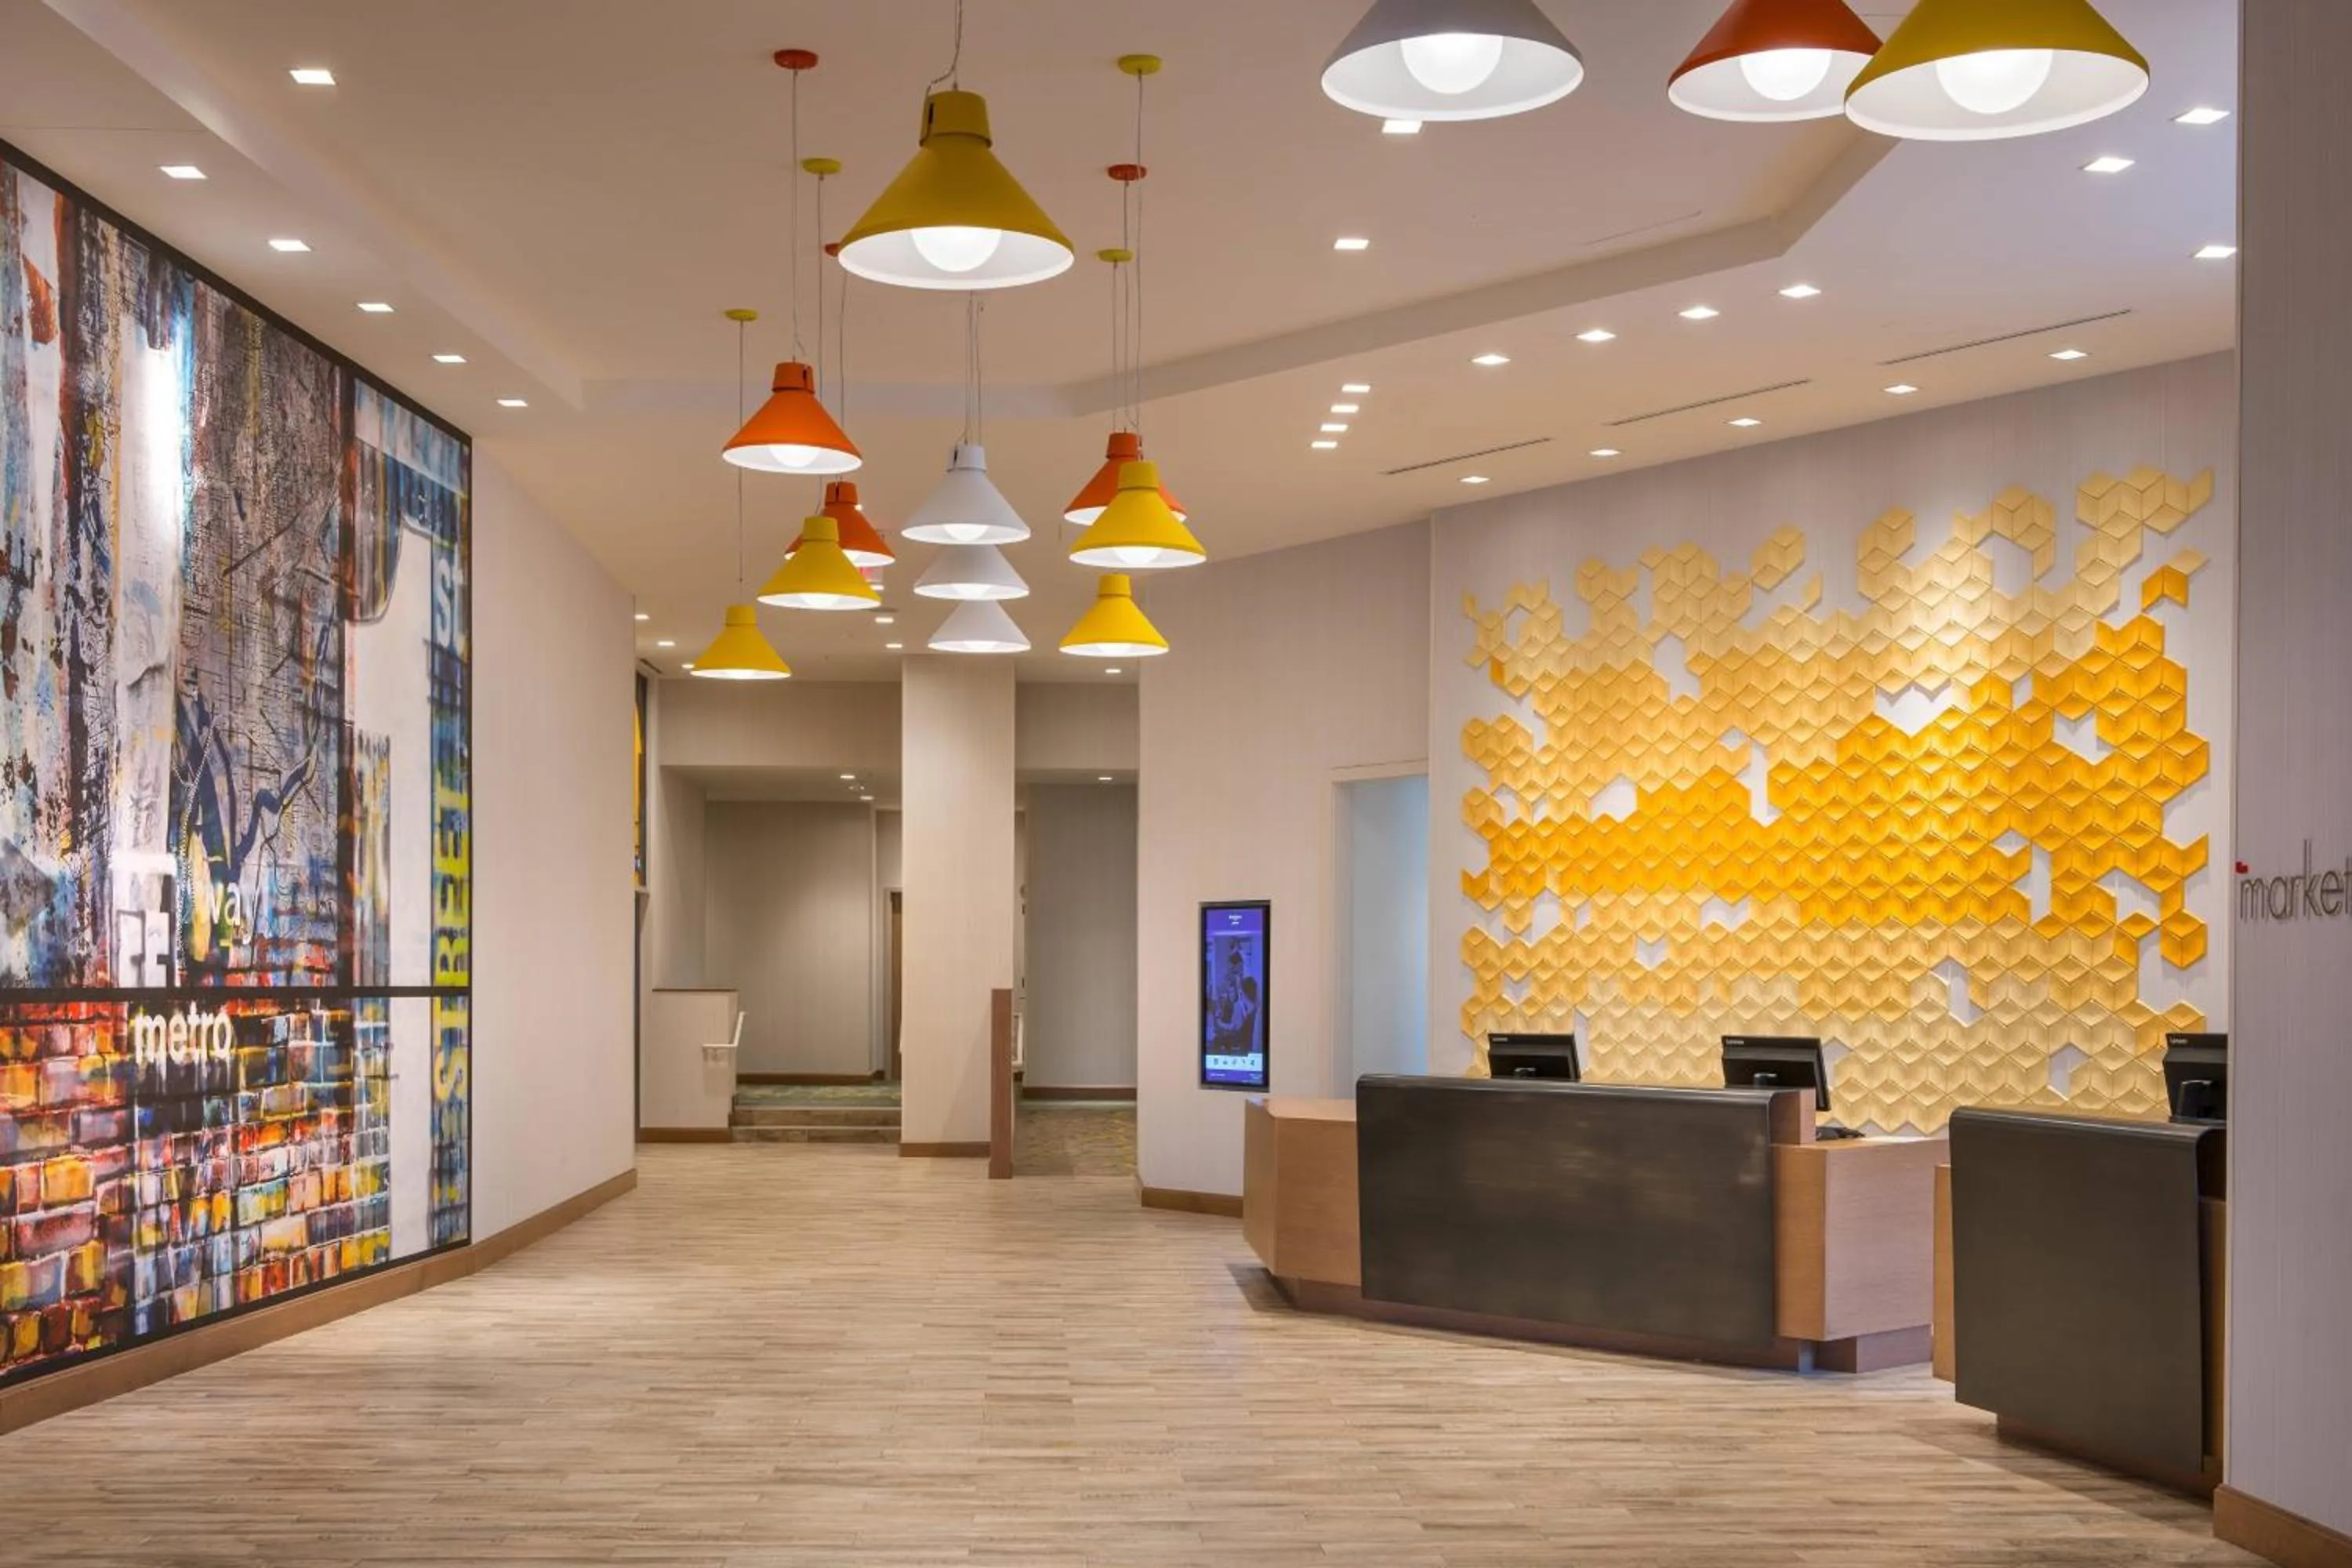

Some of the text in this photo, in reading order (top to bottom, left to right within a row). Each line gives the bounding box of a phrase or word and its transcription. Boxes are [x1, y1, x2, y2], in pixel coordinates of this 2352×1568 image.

[2240, 839, 2352, 920] market
[433, 767, 469, 1102] STREET
[135, 1000, 233, 1065] metro
